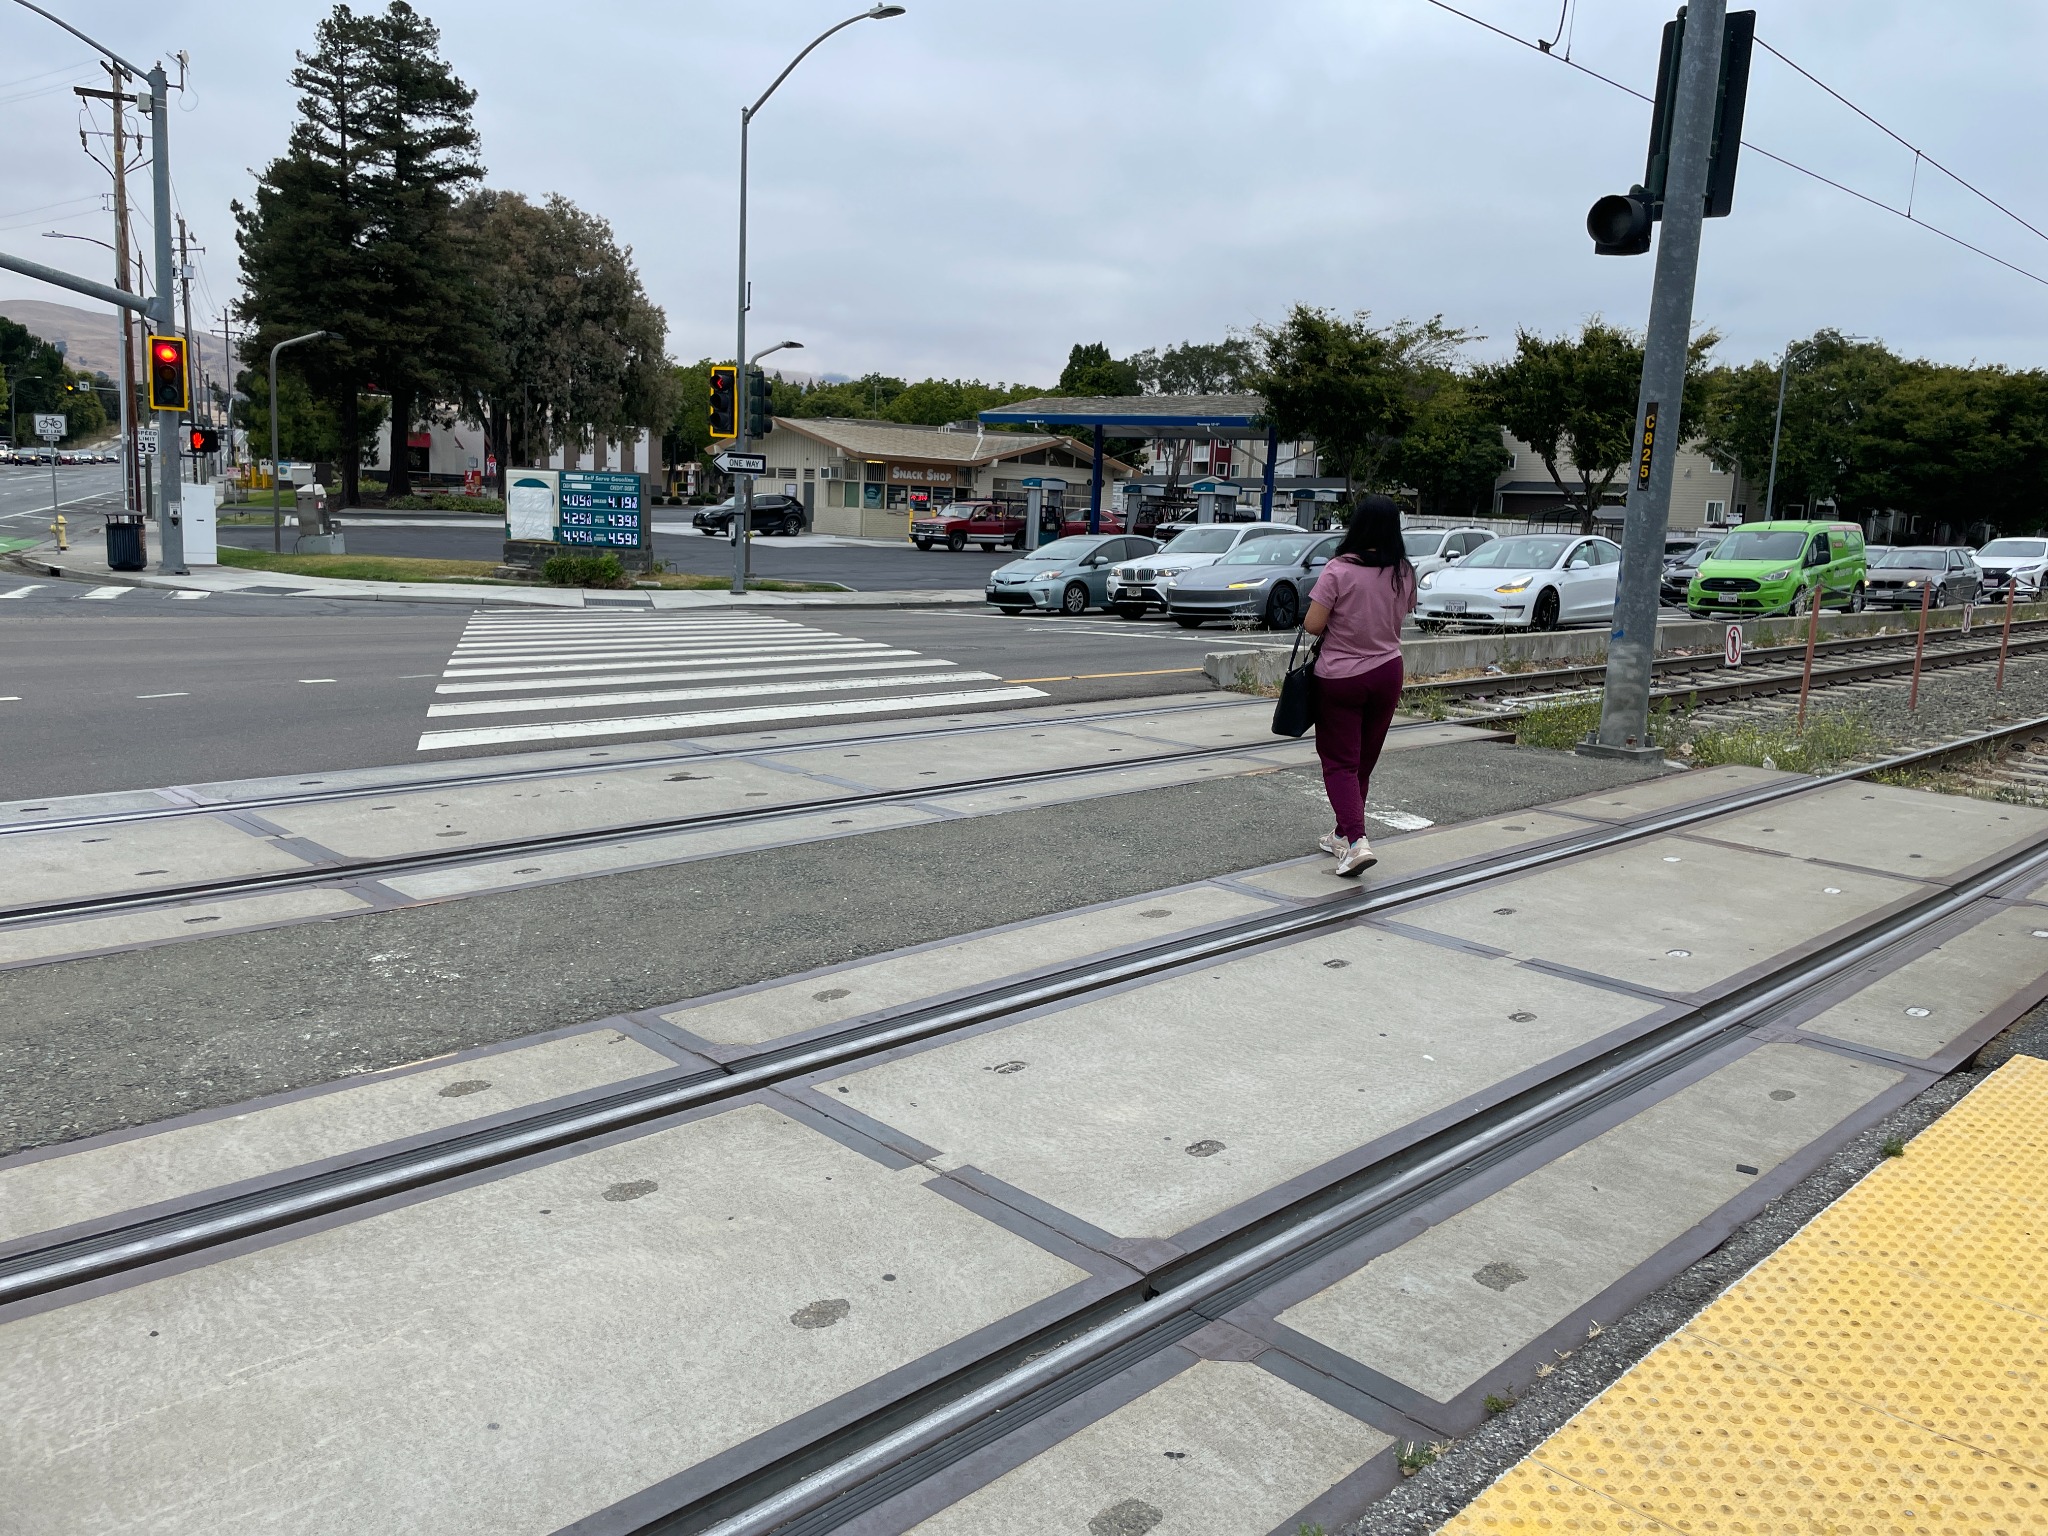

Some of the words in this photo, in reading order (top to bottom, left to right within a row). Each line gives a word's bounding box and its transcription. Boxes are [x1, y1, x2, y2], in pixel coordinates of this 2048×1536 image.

[138, 442, 156, 452] 35
[1640, 414, 1656, 478] C825
[729, 459, 744, 467] ONE
[746, 460, 760, 468] WAY
[892, 466, 923, 480] SNACK
[927, 468, 952, 481] SHOP
